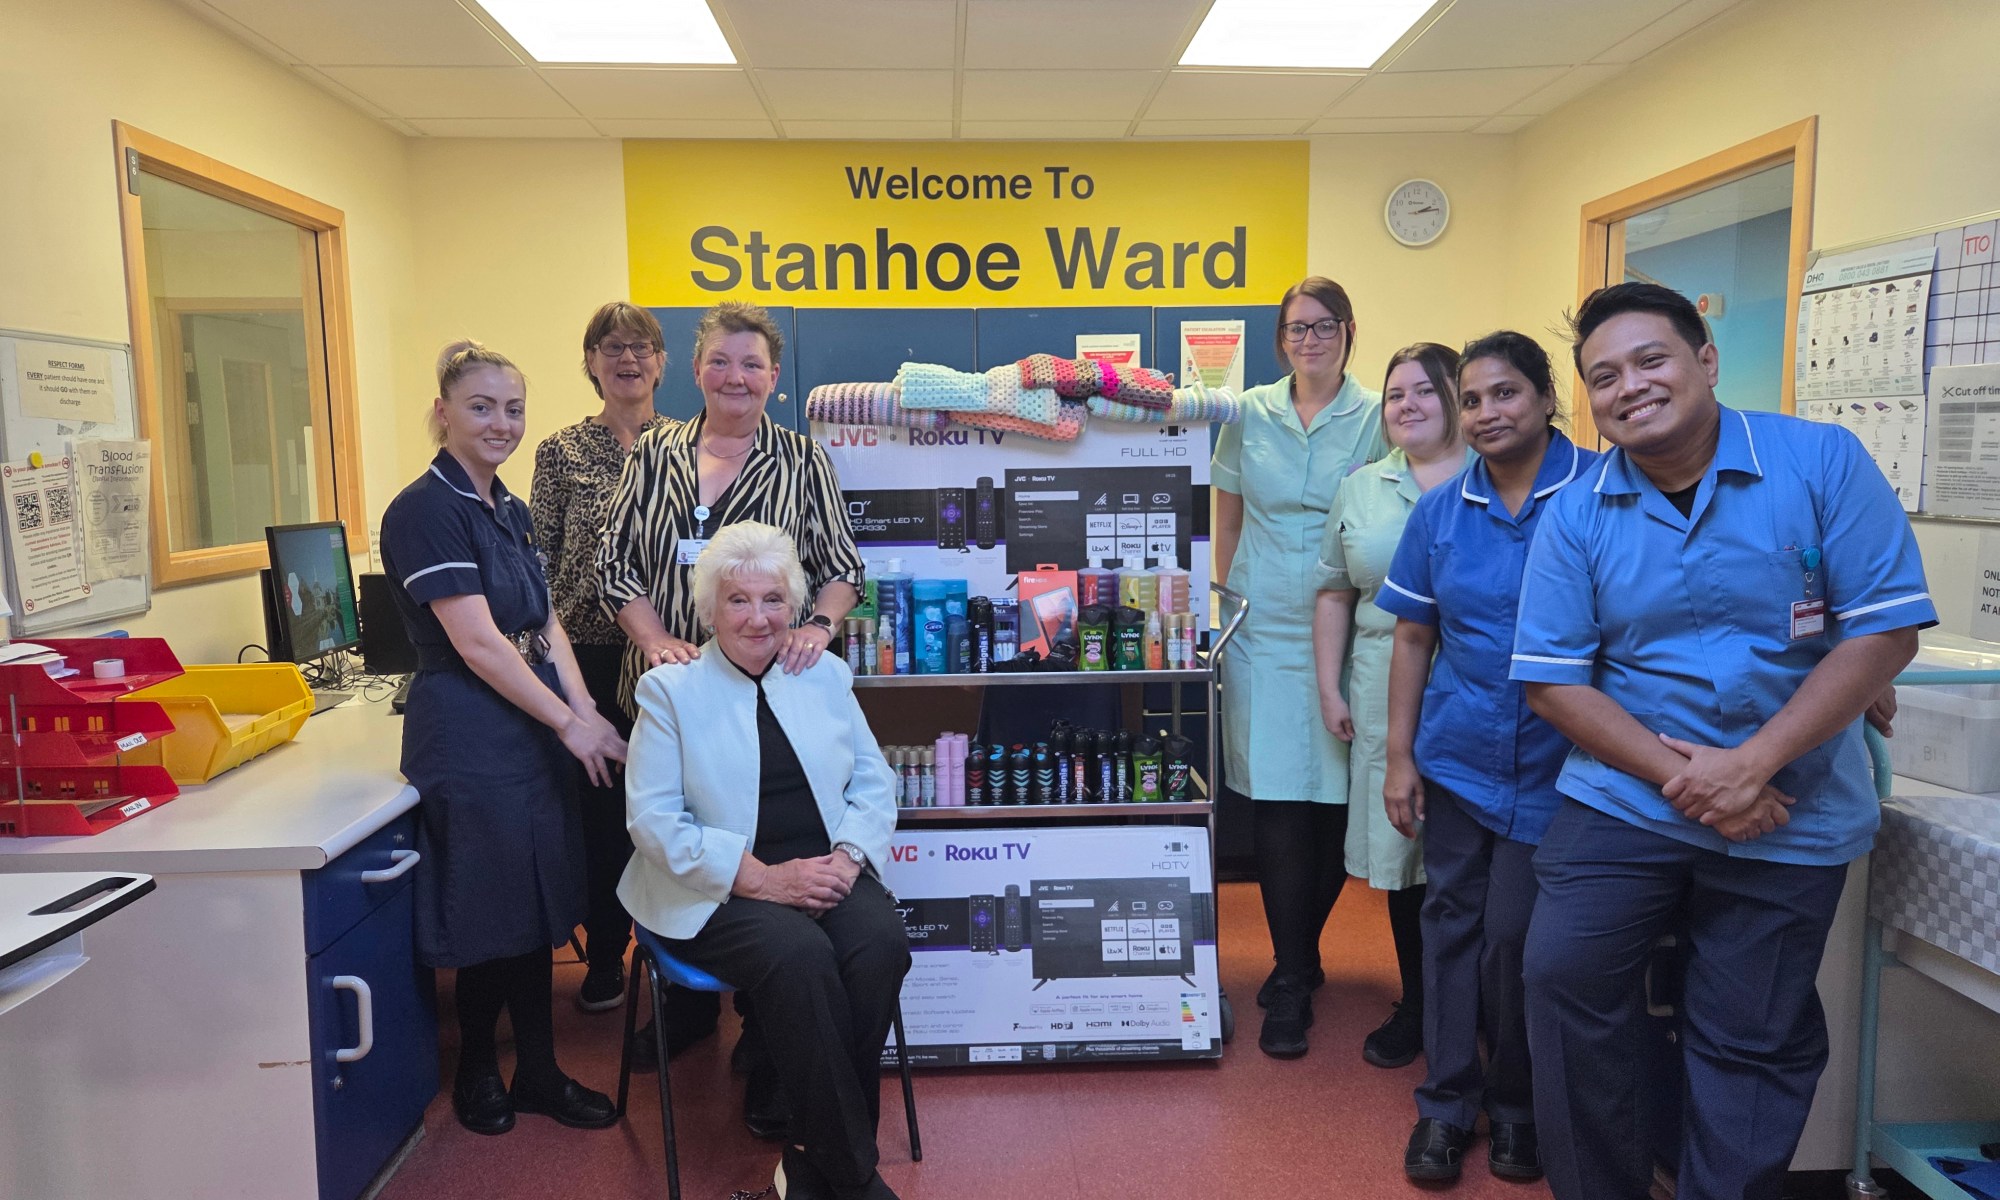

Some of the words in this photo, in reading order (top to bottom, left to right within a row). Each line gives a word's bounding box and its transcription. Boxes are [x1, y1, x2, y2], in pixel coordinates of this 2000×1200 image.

[845, 166, 1032, 199] Welcome
[1044, 166, 1095, 199] To
[690, 225, 1020, 292] Stanhoe
[1045, 226, 1247, 291] Ward
[48, 360, 67, 369] RESPECT
[68, 361, 85, 370] FORMS
[27, 371, 43, 380] EVERY
[44, 373, 60, 381] patient
[61, 374, 76, 383] should
[79, 387, 90, 395] them
[1955, 387, 1971, 396] Cut
[1973, 386, 1986, 395] off
[60, 398, 81, 406] discharge
[831, 427, 878, 447] JVC
[909, 427, 968, 446] Roku
[974, 428, 1005, 445] TV
[101, 450, 133, 462] Blood
[1121, 447, 1159, 457] FULL
[1164, 447, 1187, 457] HD
[87, 464, 144, 476] Transfusion
[846, 501, 872, 516] 0"
[1983, 586, 2000, 598] NOT
[1981, 603, 1991, 613] AT
[980, 641, 989, 672] insignia
[120, 741, 134, 749] MAIL
[134, 736, 143, 744] OUT
[1059, 768, 1068, 799] insignia
[1075, 770, 1085, 801] insignia
[1102, 769, 1111, 801] insignia
[1117, 768, 1126, 799] insignia
[123, 805, 136, 813] MAIL
[887, 846, 918, 862] VC
[945, 844, 997, 861] Roku
[1002, 843, 1031, 860] TV
[1152, 861, 1189, 870] HDTV
[1130, 1020, 1150, 1028] Dolby
[1151, 1019, 1171, 1027] Audio
